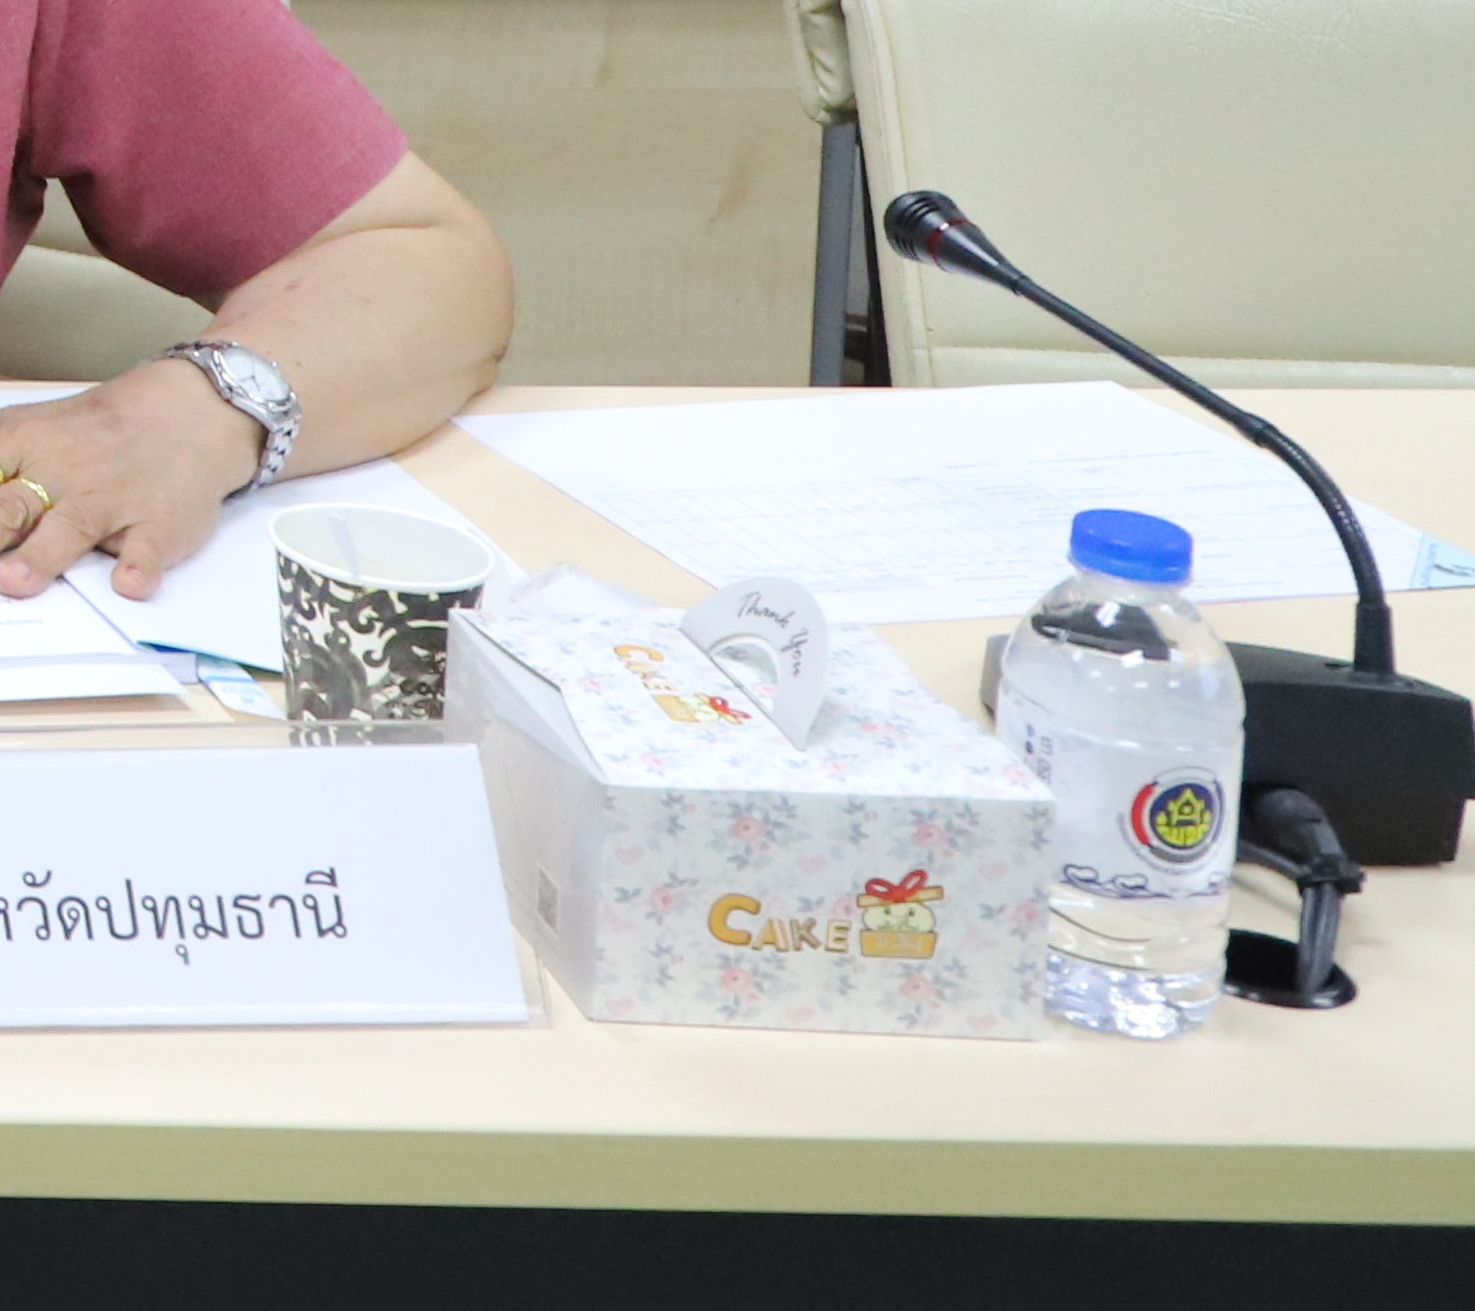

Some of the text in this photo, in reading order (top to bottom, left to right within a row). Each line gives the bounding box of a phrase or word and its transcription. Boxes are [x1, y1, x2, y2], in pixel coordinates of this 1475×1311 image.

[737, 590, 810, 677] Thank You
[707, 892, 852, 954] CAKE
